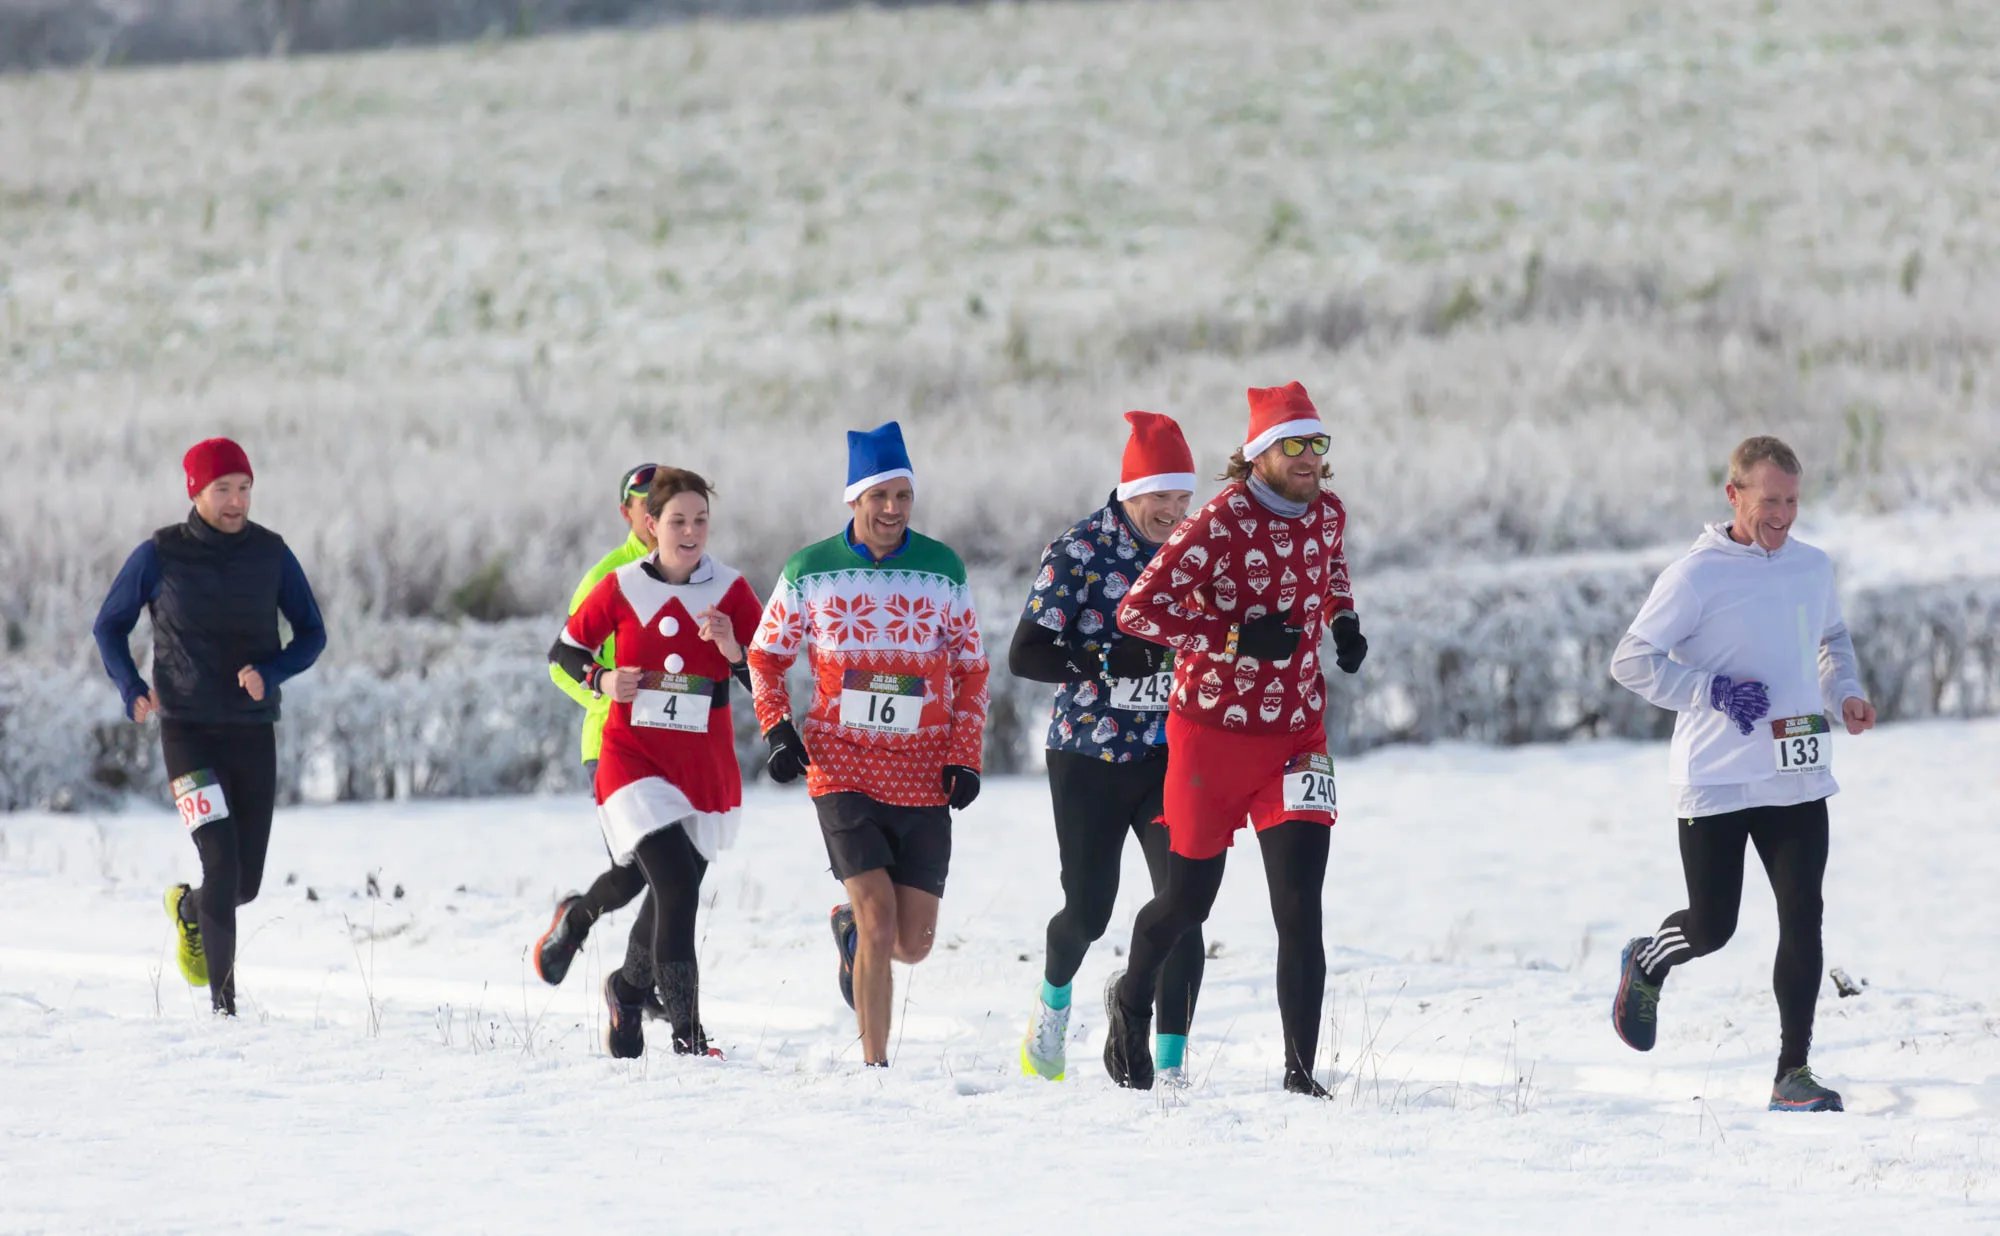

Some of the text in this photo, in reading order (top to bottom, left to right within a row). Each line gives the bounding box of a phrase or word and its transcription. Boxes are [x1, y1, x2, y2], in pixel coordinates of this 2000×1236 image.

[663, 673, 688, 683] ZIG ZAG
[872, 674, 897, 684] ZIG ZAG
[1129, 674, 1171, 702] 243
[663, 695, 677, 720] 4
[868, 695, 895, 724] 16
[1781, 737, 1819, 767] 133
[1301, 773, 1337, 806] 240
